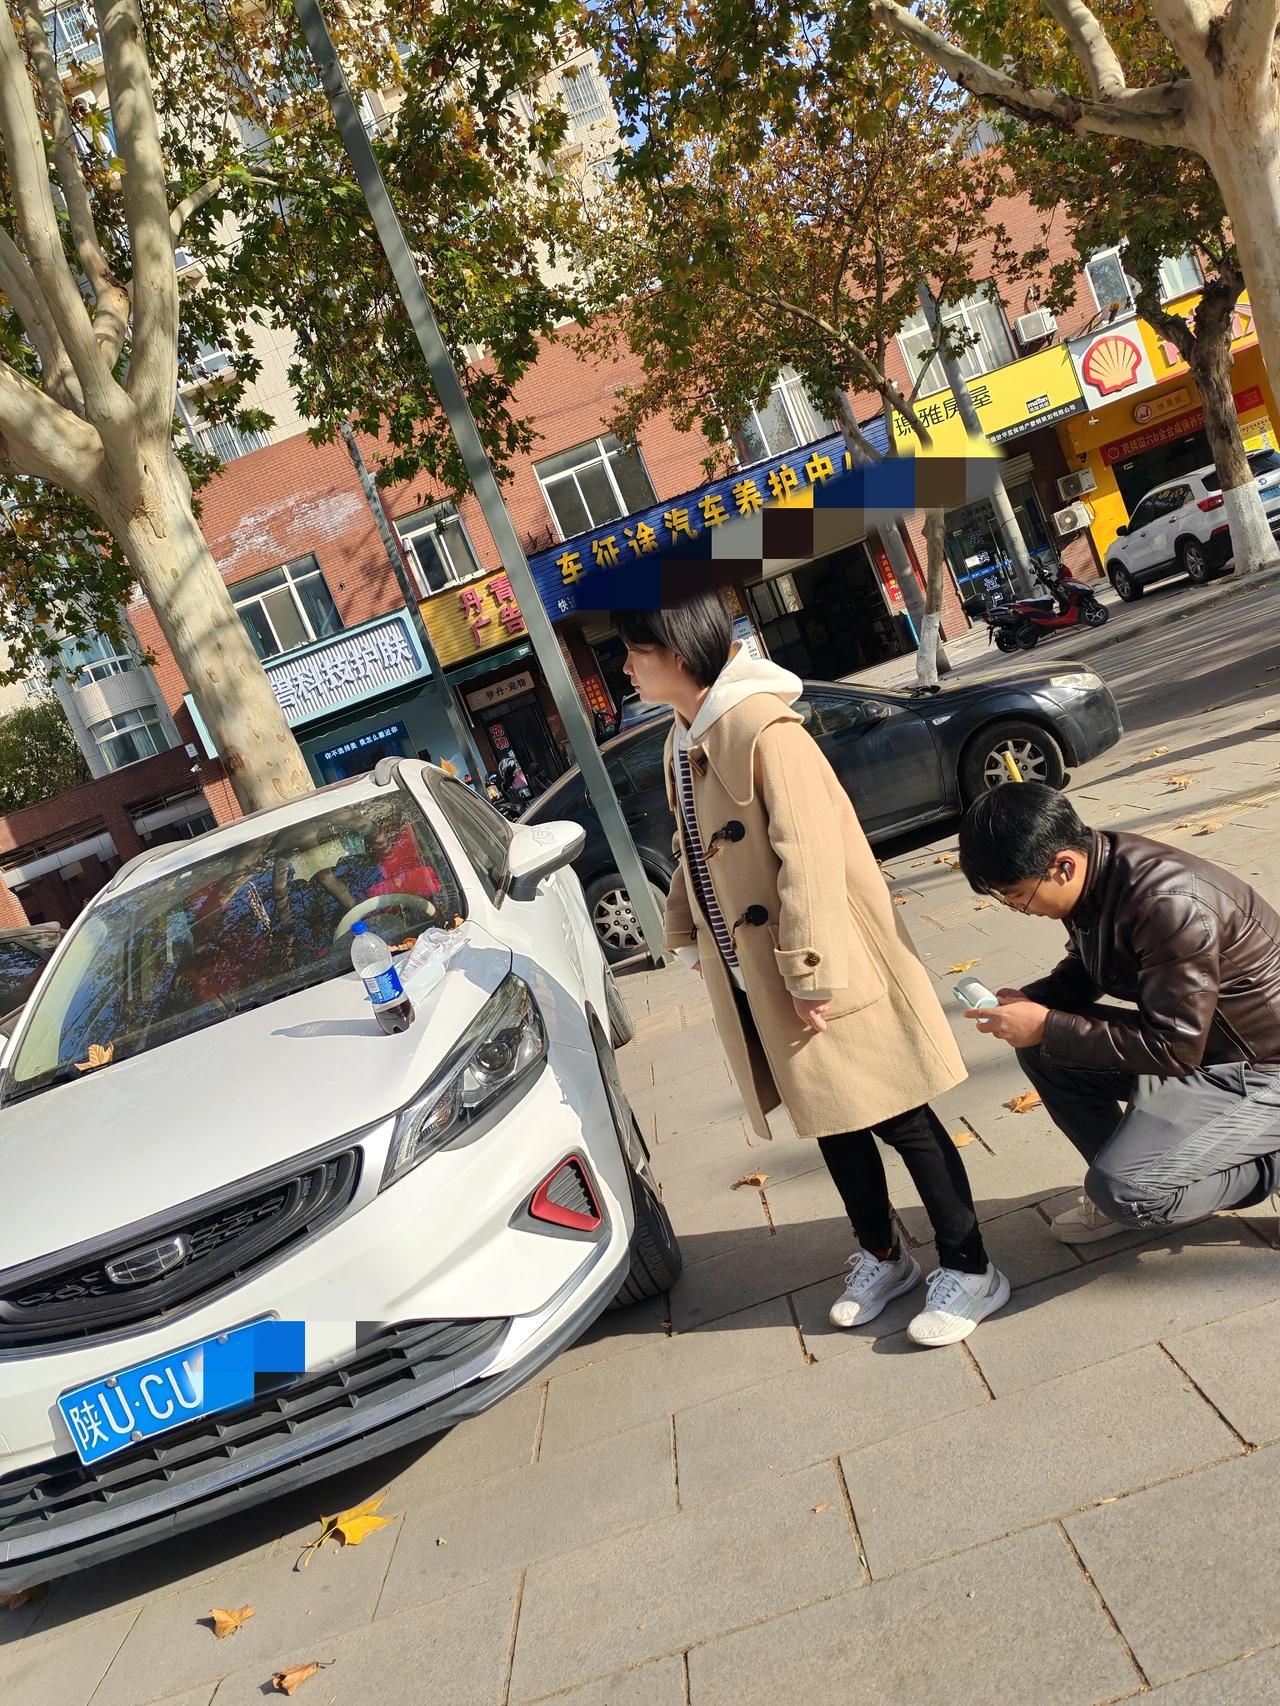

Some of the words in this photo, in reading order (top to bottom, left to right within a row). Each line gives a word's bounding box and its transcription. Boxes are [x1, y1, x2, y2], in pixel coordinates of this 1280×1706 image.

[556, 451, 852, 585] 车征途汽车养护中
[460, 575, 515, 619] 丹青
[471, 604, 526, 648] 广告
